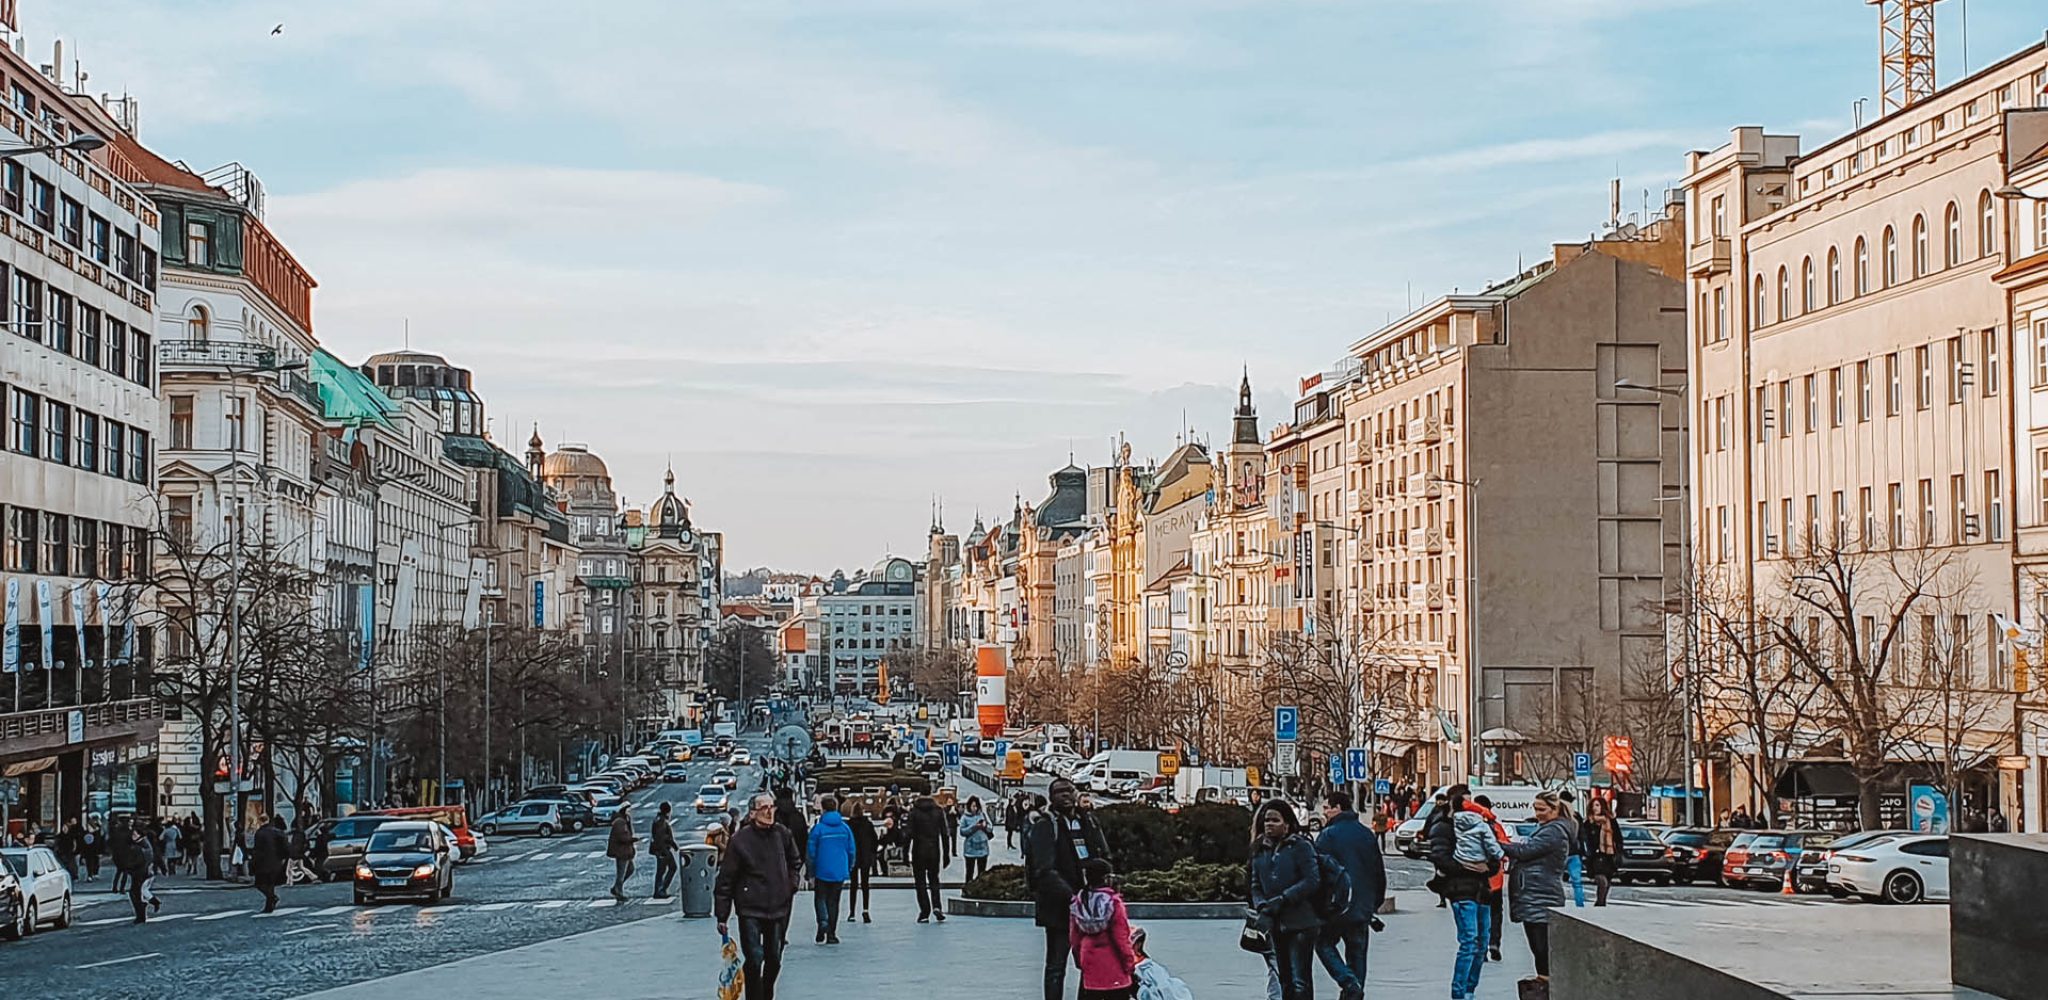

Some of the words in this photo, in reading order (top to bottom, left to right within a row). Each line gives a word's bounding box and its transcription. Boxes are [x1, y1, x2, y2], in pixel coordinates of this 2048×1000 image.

[1155, 510, 1193, 538] MERAN
[1280, 711, 1292, 730] P
[1577, 756, 1587, 769] P
